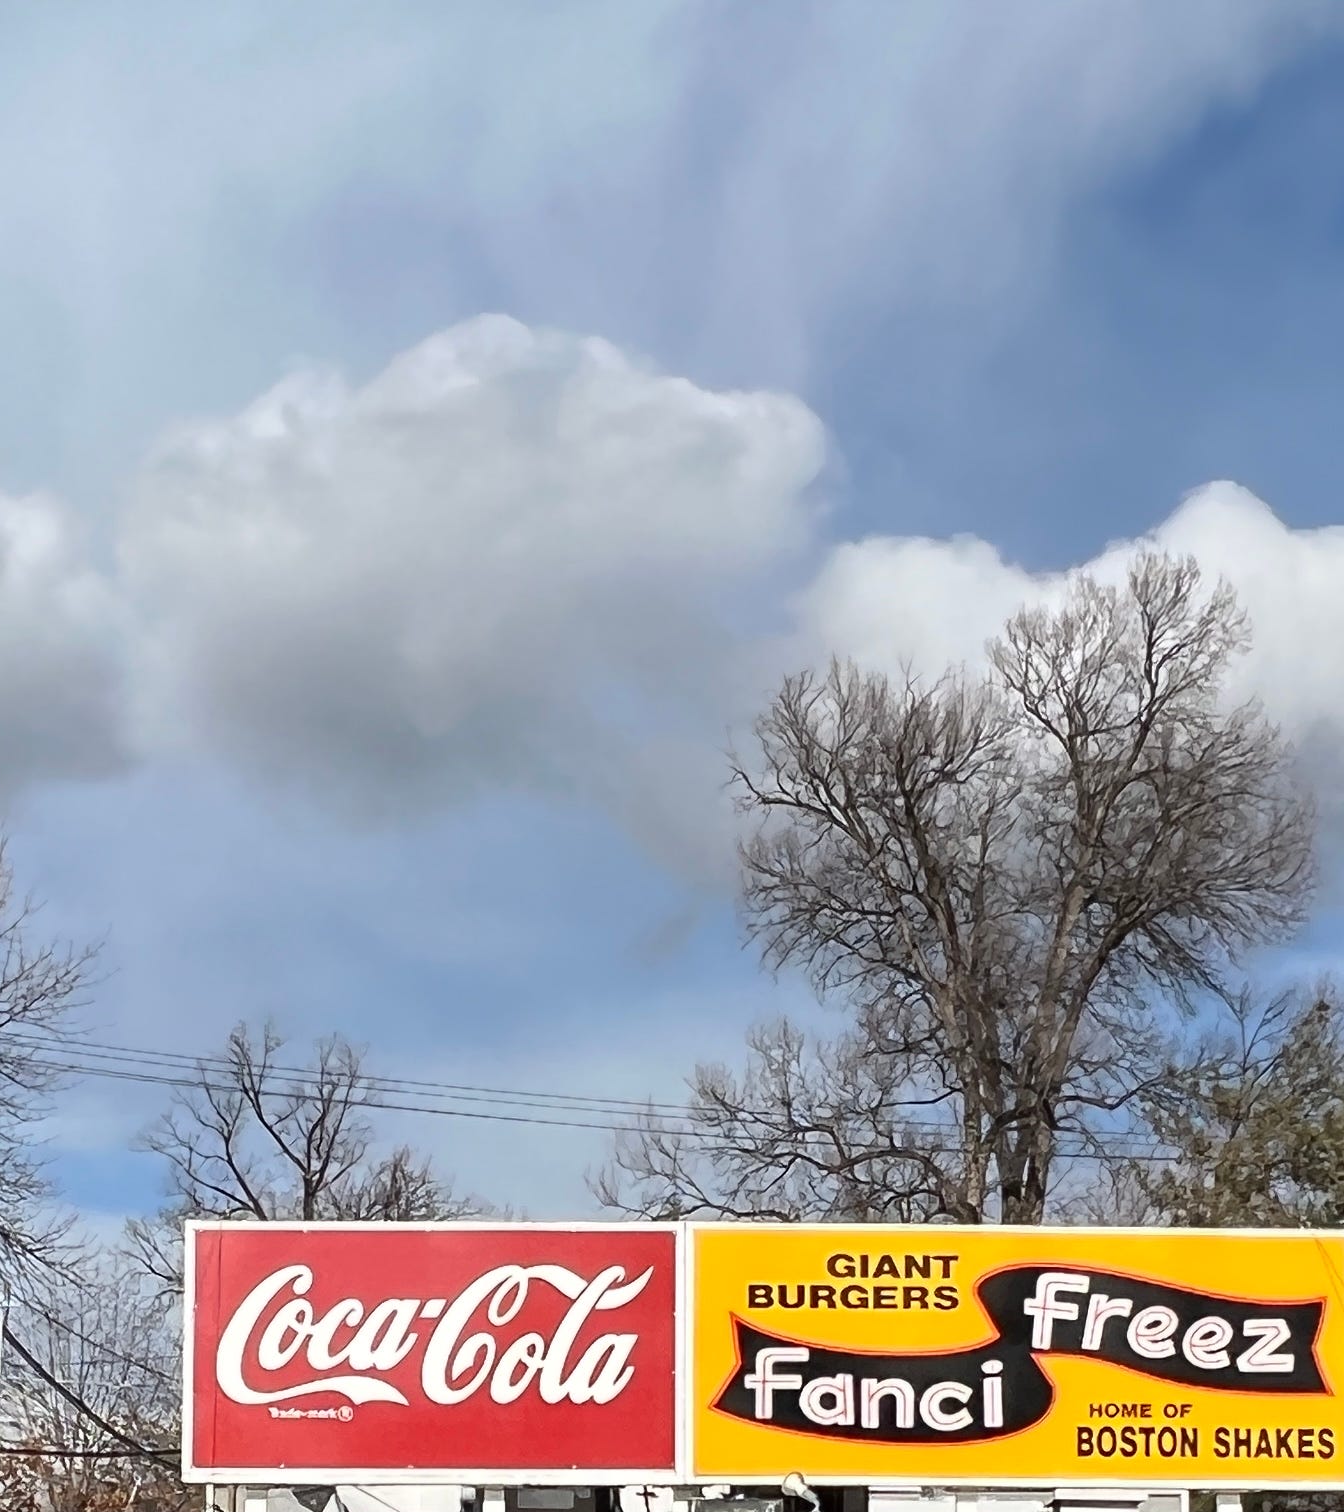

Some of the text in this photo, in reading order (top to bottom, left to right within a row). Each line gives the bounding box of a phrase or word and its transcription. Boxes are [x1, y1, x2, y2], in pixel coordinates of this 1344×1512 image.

[825, 1253, 960, 1280] GIANT
[747, 1284, 960, 1311] BURGERS
[216, 1264, 654, 1406] Coca-Cola
[1023, 1271, 1296, 1374] freez
[743, 1346, 1005, 1432] fanci
[1088, 1403, 1194, 1419] HOME OF
[1075, 1426, 1336, 1460] BOSTON SHAKES
